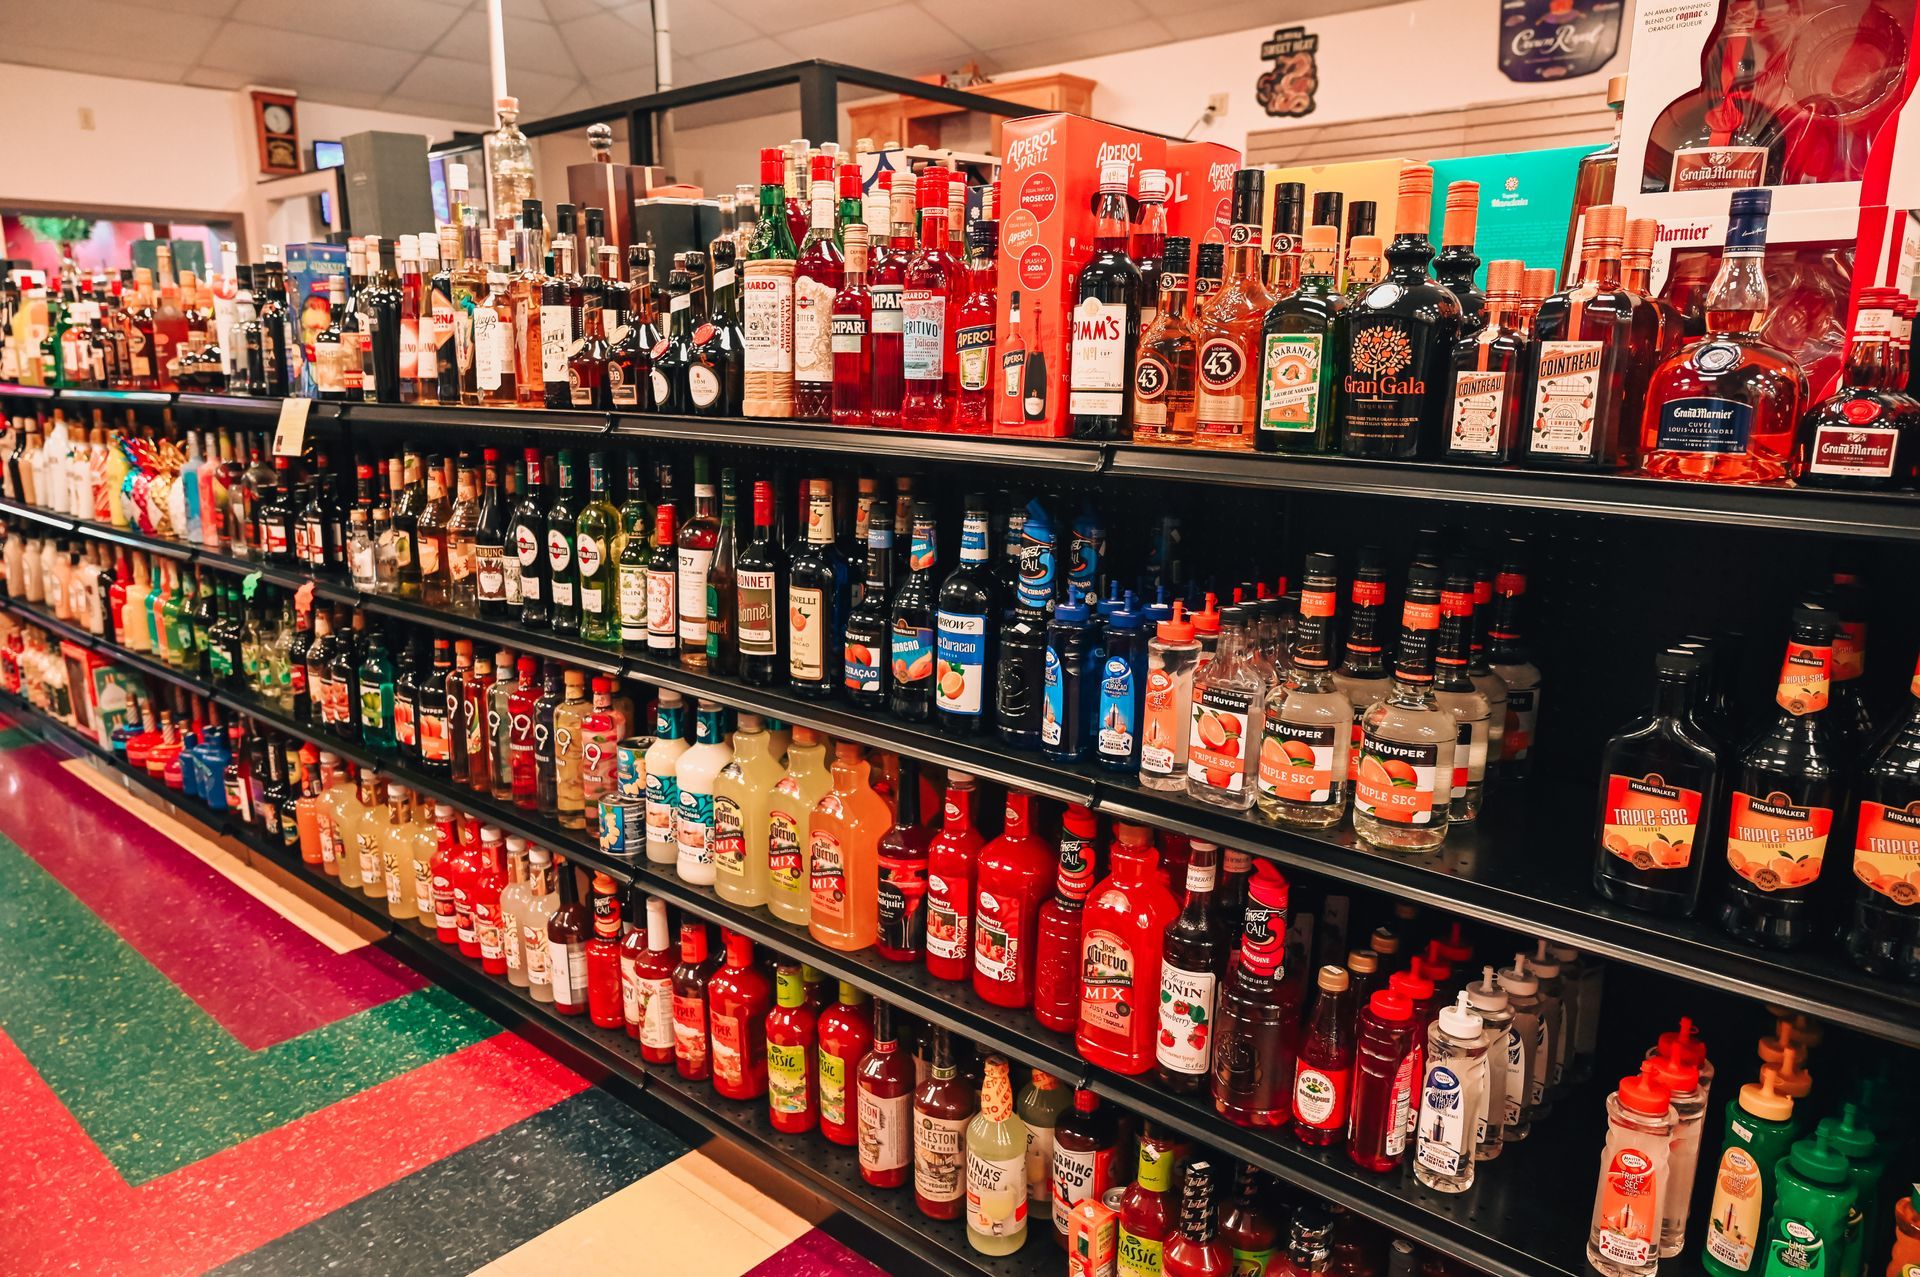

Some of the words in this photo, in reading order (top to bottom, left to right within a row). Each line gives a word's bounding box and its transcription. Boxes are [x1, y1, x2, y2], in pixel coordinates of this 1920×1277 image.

[1654, 7, 1678, 16] AWARD
[1679, 2, 1712, 11] WINNING
[1645, 18, 1664, 26] BLEND
[1675, 10, 1703, 22] cognac
[1648, 24, 1675, 33] ORANGE
[1675, 20, 1703, 29] LIQUEUR
[1006, 128, 1057, 164] APEROL
[1014, 147, 1048, 172] SPRITZ
[1022, 194, 1054, 203] PROSECCO
[1008, 229, 1034, 245] APEROL
[1231, 229, 1246, 242] 43
[1273, 237, 1289, 252] 43
[1162, 277, 1172, 287] 43
[1196, 282, 1206, 291] 43
[1073, 315, 1120, 341] PIMM'S
[957, 330, 996, 349] APEROL
[1003, 353, 1024, 367] APEROL
[1273, 345, 1313, 360] NARANJA
[1204, 352, 1233, 376] 43
[1540, 350, 1600, 377] COINTREAU
[1138, 370, 1157, 388] 43
[1344, 375, 1377, 395] Gran
[1380, 375, 1425, 395] Gala
[1458, 376, 1502, 397] COINTREAU
[1673, 408, 1696, 418] Grand
[1695, 408, 1733, 419] Marnier
[1668, 427, 1734, 435] LOUIS-ALEXANDRE
[1821, 442, 1850, 454] Grand
[1848, 443, 1889, 456] Marnier
[1315, 598, 1327, 606] SEC
[942, 637, 976, 653] Curacao
[1203, 694, 1213, 702] DE
[1213, 696, 1246, 709] KUYPER
[1265, 721, 1275, 730] DE
[1275, 723, 1322, 739] KUYPER
[1364, 738, 1374, 750] DE
[1376, 743, 1425, 759] KUYPER
[1194, 751, 1217, 765] TRIPLE
[1219, 758, 1236, 769] SEC
[1260, 762, 1287, 781] TRIPLE
[1291, 772, 1315, 785] SEC
[1358, 782, 1388, 801] TRIPLE
[1392, 791, 1417, 806] SEC
[1632, 782, 1651, 793] HIRAM
[1651, 786, 1676, 798] WALKER
[1752, 801, 1776, 814] HIRAM
[1776, 807, 1806, 819] WALKER
[1887, 811, 1915, 824] HIRAM
[770, 823, 797, 842] Cuervo
[715, 839, 739, 850] MIX
[770, 855, 797, 867] MIX
[812, 843, 839, 864] Cuervo
[1061, 852, 1080, 866] CALL
[812, 876, 838, 889] MIX
[1246, 922, 1267, 938] CALL
[1087, 944, 1128, 972] Cuervo
[1085, 986, 1125, 1001] MIX
[1105, 1008, 1119, 1019] ADD
[1103, 1018, 1125, 1029] TEQUILA
[1621, 1170, 1645, 1184] TRIPLE
[1624, 1180, 1639, 1190] SEC
[1608, 1249, 1638, 1261] ESSENTIALS
[1611, 1246, 1635, 1256] COCKTAIL
[1712, 1246, 1738, 1264] ESSENTIALS
[1714, 1243, 1736, 1257] COCKTAIL
[1785, 1248, 1808, 1261] JUICE
